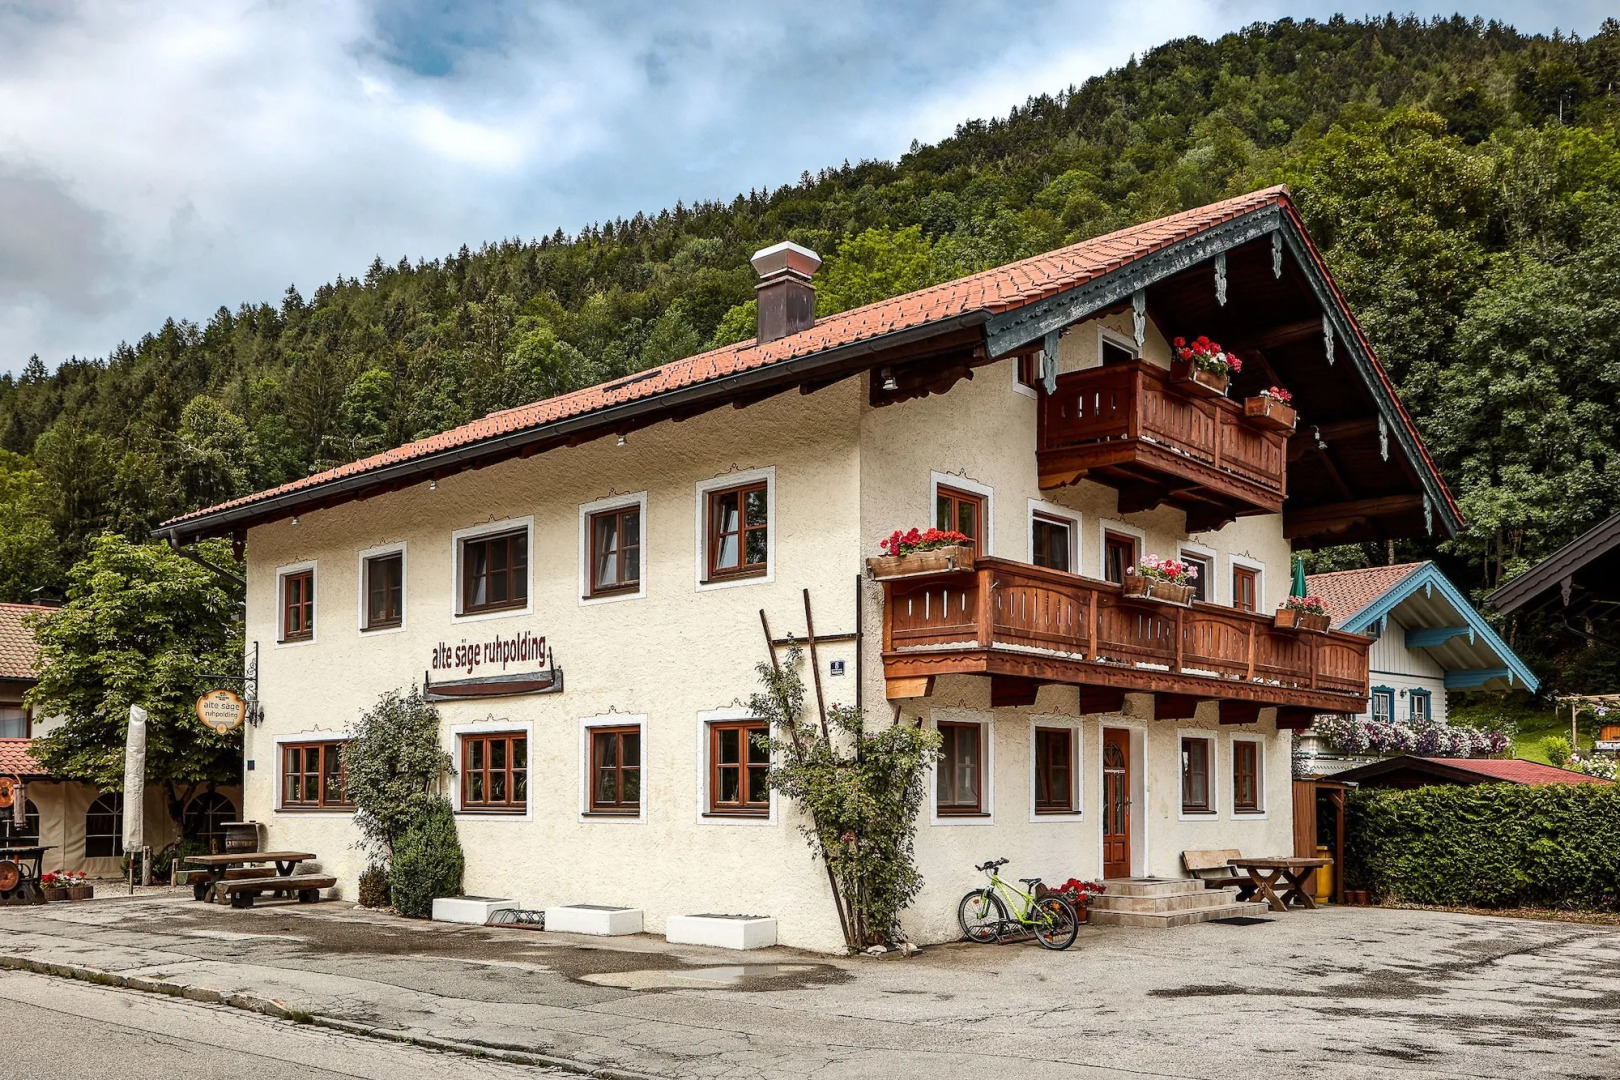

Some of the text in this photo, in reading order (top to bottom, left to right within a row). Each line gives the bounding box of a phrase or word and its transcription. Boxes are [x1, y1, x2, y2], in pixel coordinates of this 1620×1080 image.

[432, 641, 452, 669] alte
[455, 638, 481, 674] säge
[203, 701, 219, 709] alte
[205, 710, 238, 719] ruhpolding
